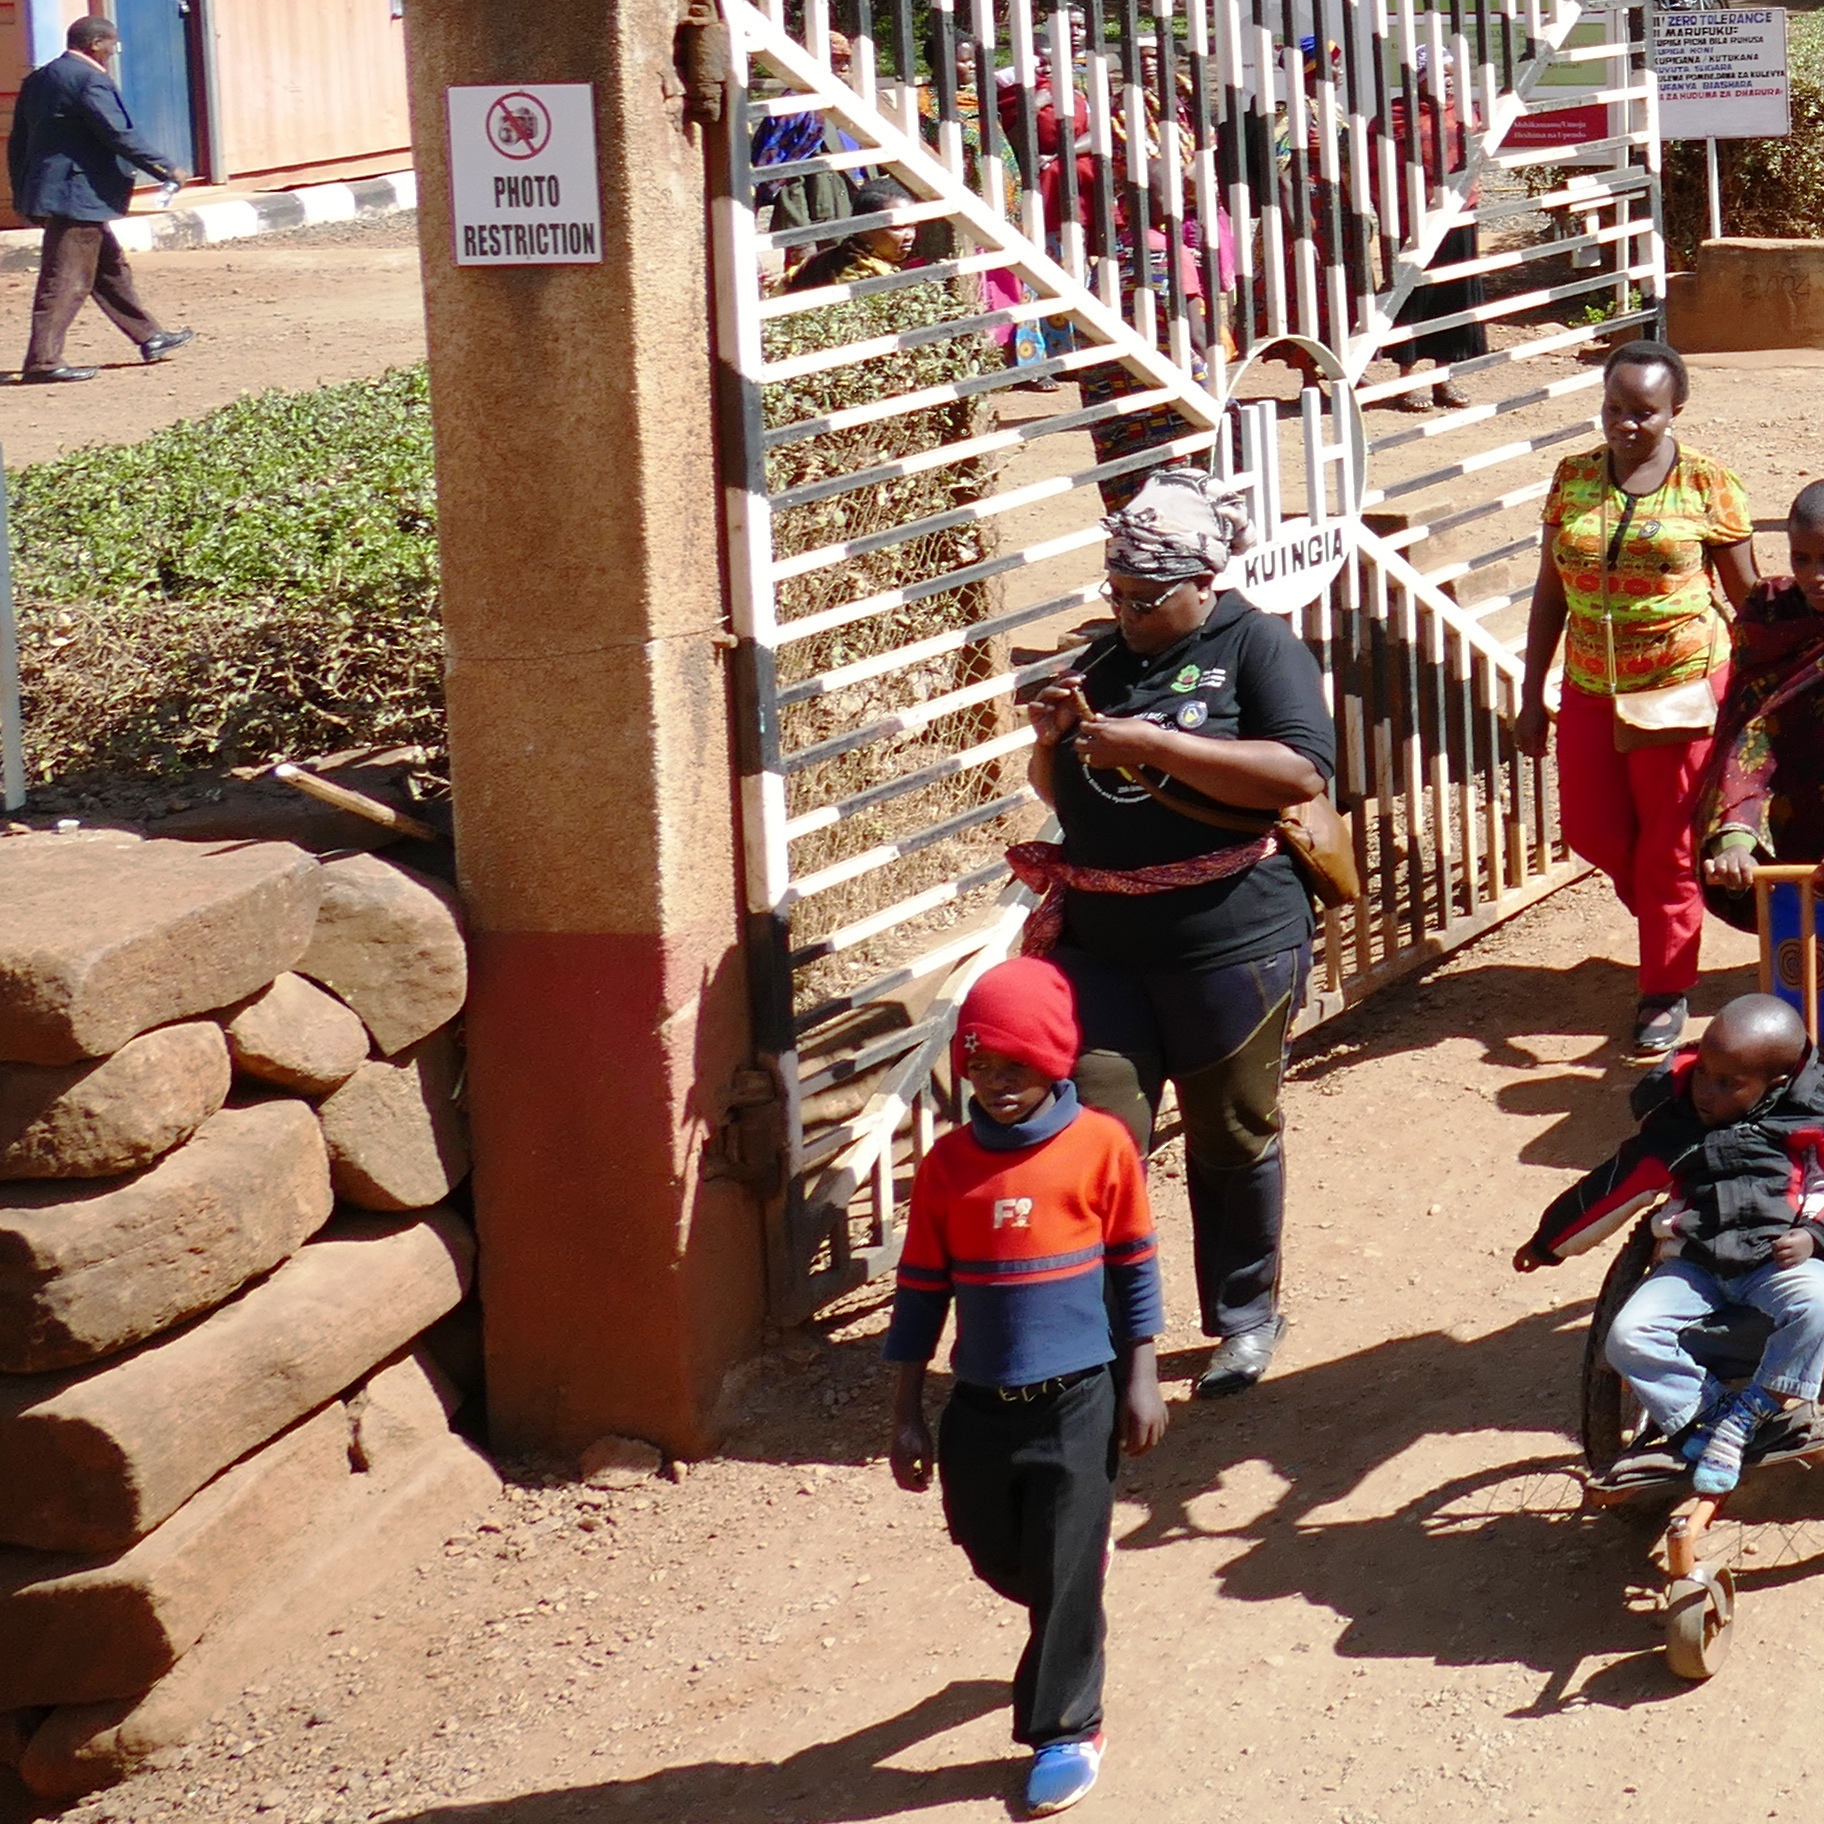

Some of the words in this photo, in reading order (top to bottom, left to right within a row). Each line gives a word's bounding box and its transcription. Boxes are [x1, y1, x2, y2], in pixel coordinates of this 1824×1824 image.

[1667, 15, 1697, 27] ZERO
[1700, 12, 1773, 26] TOLERANCE
[1709, 37, 1727, 45] BILA
[1656, 48, 1685, 56] UPIGA
[1655, 65, 1690, 74] UVUTA
[493, 174, 561, 209] PHOTO
[464, 222, 596, 257] RESTRICTION
[1244, 527, 1344, 588] KUINGIA
